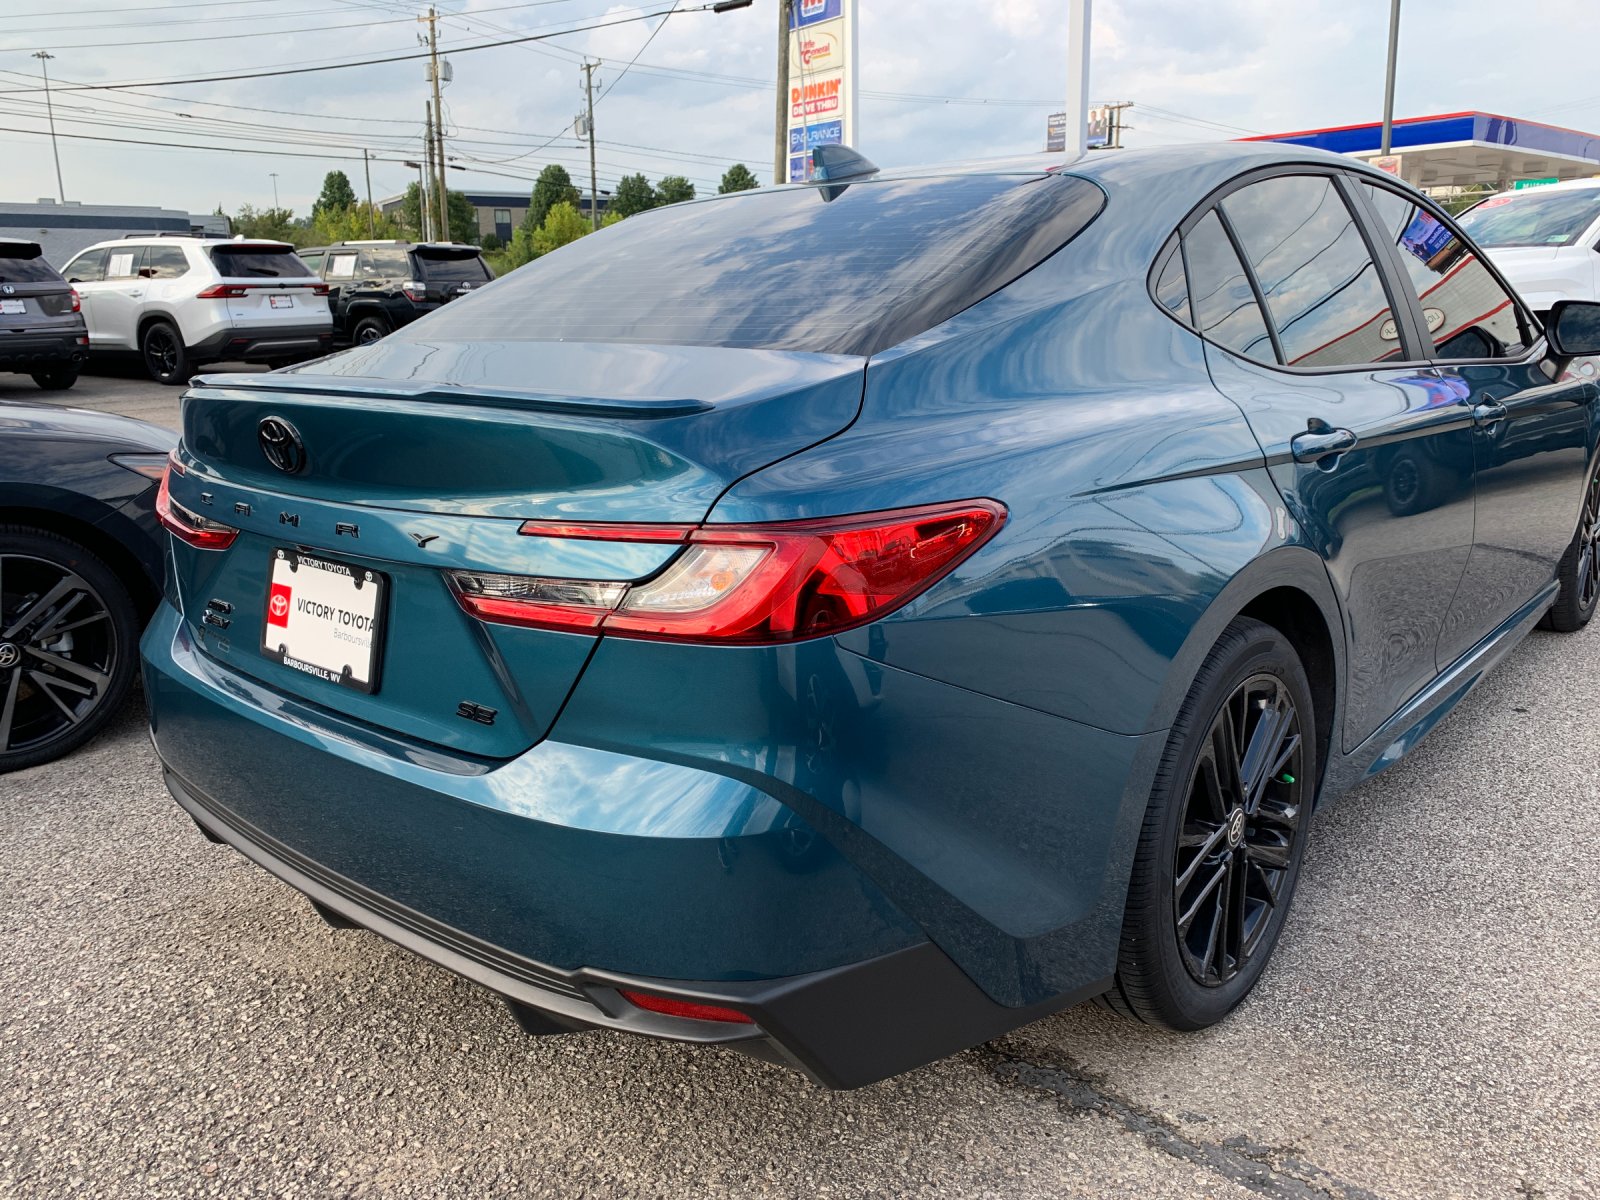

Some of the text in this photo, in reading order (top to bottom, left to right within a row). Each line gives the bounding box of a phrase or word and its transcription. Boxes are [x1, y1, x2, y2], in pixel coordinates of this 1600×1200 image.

[800, 42, 831, 65] General
[791, 78, 841, 104] DUNKIN'
[816, 98, 837, 111] THRU
[200, 492, 440, 548] CAMRY
[297, 555, 351, 576] VICTORY TOYOTA
[297, 597, 375, 633] VICTORY TOYOTA
[283, 656, 341, 683] BARBOURSVILLE, WV
[456, 701, 498, 726] SE
